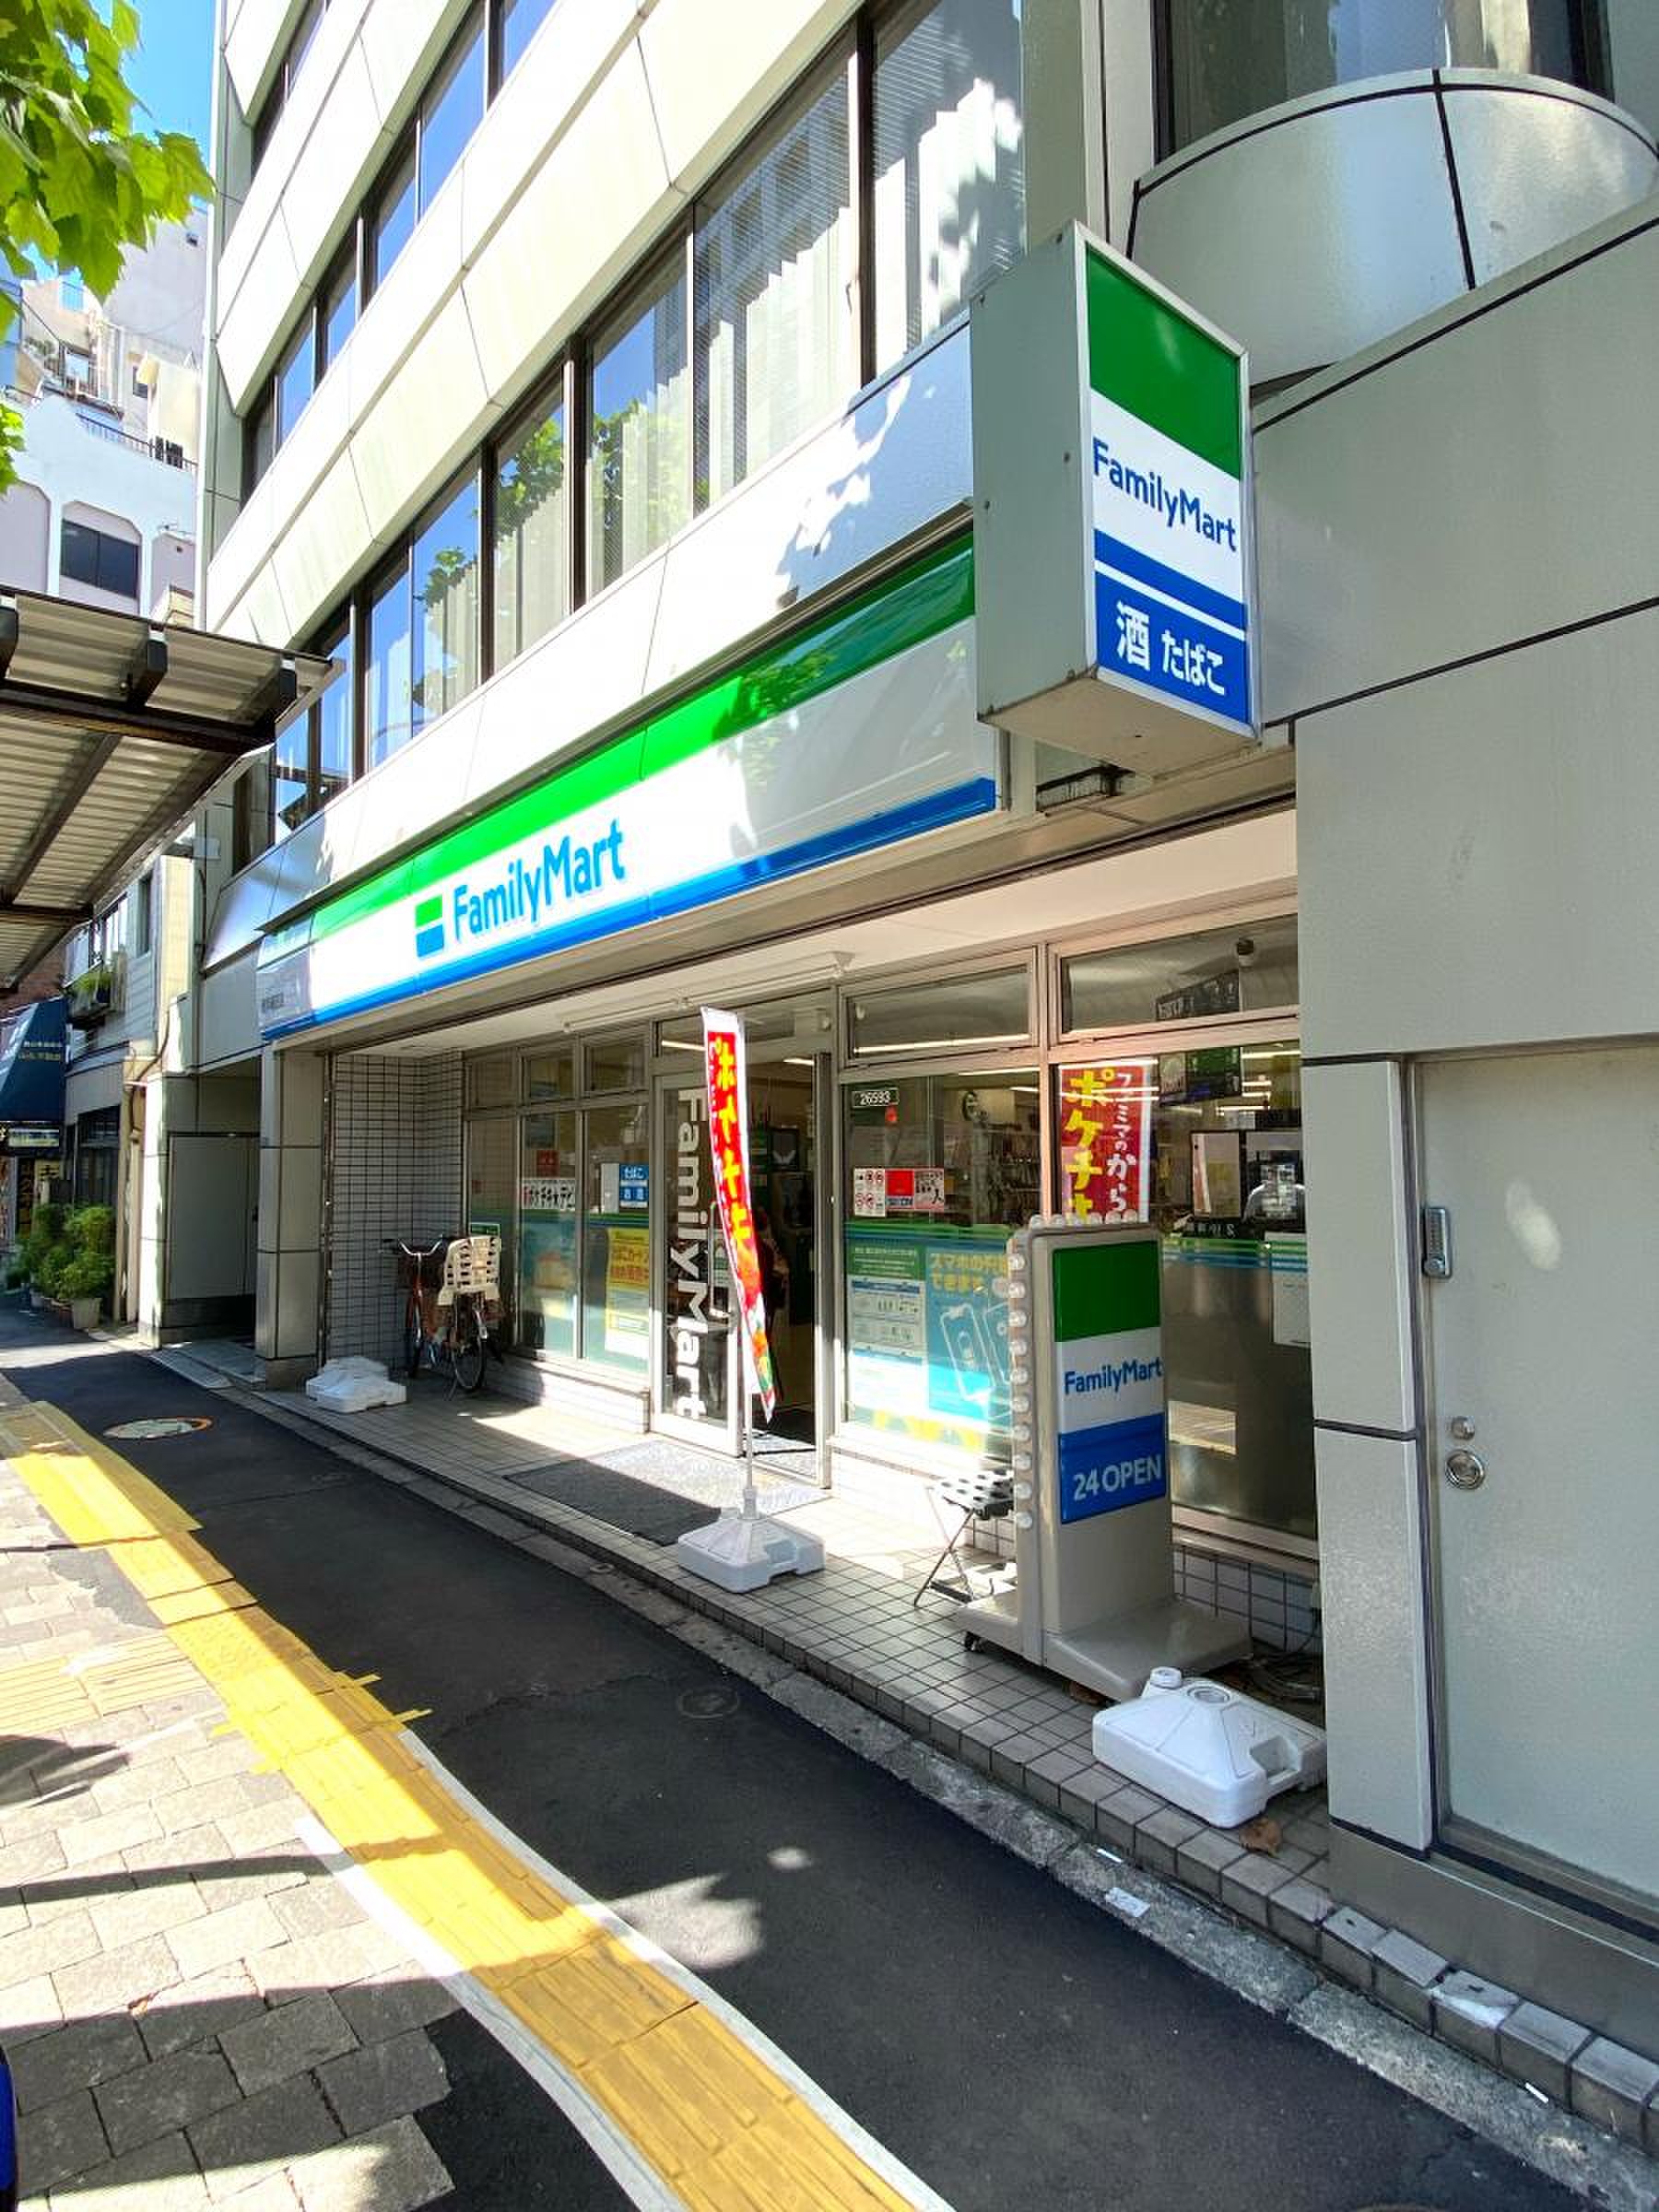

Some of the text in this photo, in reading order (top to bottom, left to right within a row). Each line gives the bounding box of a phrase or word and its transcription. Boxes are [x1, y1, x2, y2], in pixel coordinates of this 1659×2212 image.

[1093, 436, 1238, 552] FamilyMart
[1116, 600, 1227, 696] 酒 たばこ
[453, 818, 626, 941] FamilyMart
[1107, 1073, 1136, 1211] フミマのから
[670, 1089, 708, 1418] FamilyMart
[1065, 1357, 1163, 1394] FamilyMart
